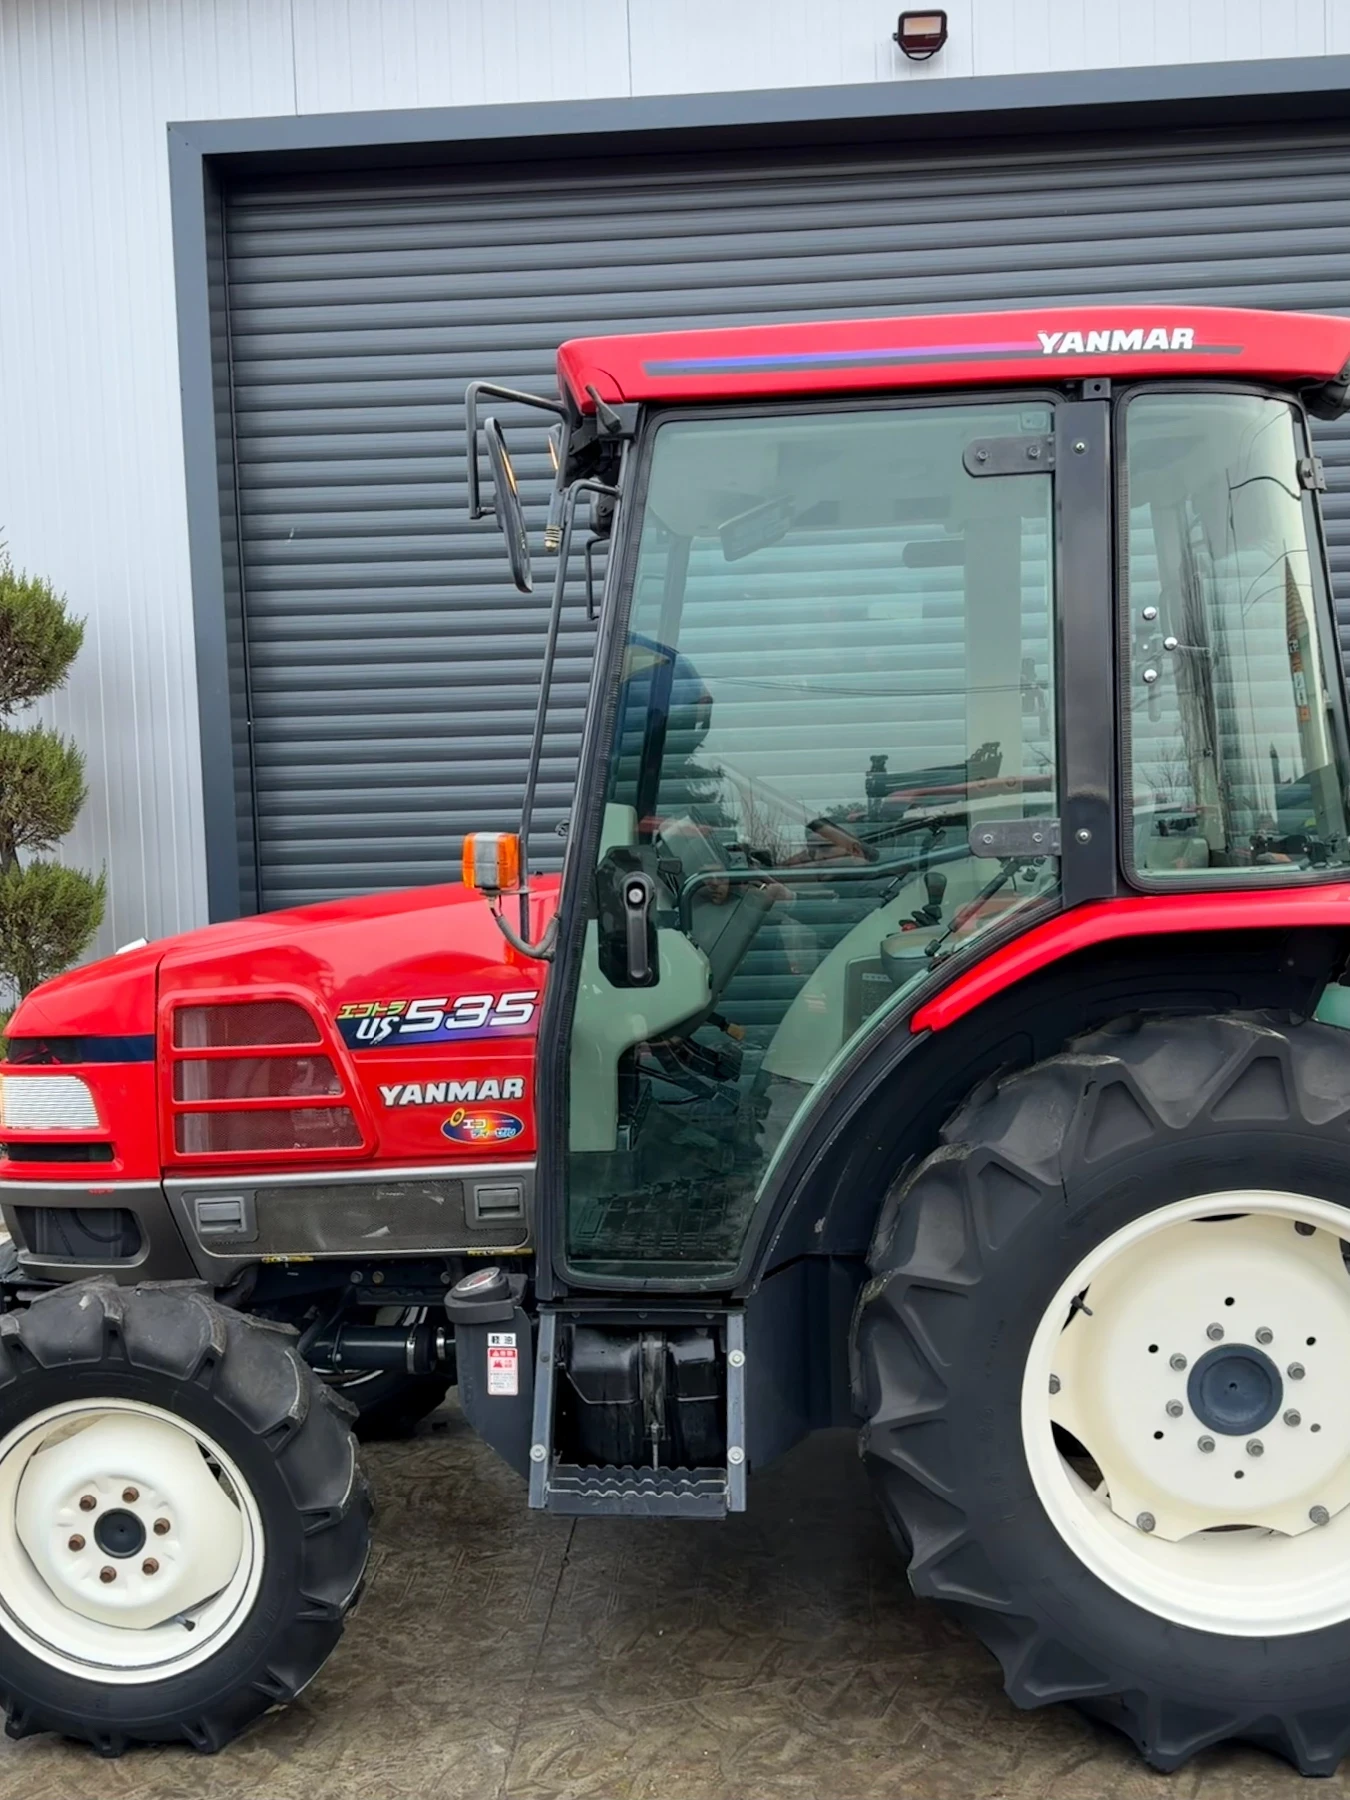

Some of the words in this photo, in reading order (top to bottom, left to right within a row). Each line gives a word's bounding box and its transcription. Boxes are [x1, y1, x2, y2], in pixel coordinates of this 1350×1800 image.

[1037, 327, 1195, 354] YANMAR
[336, 1000, 407, 1020] エコトラ
[399, 991, 539, 1034] 535
[379, 1077, 525, 1106] YANMAR
